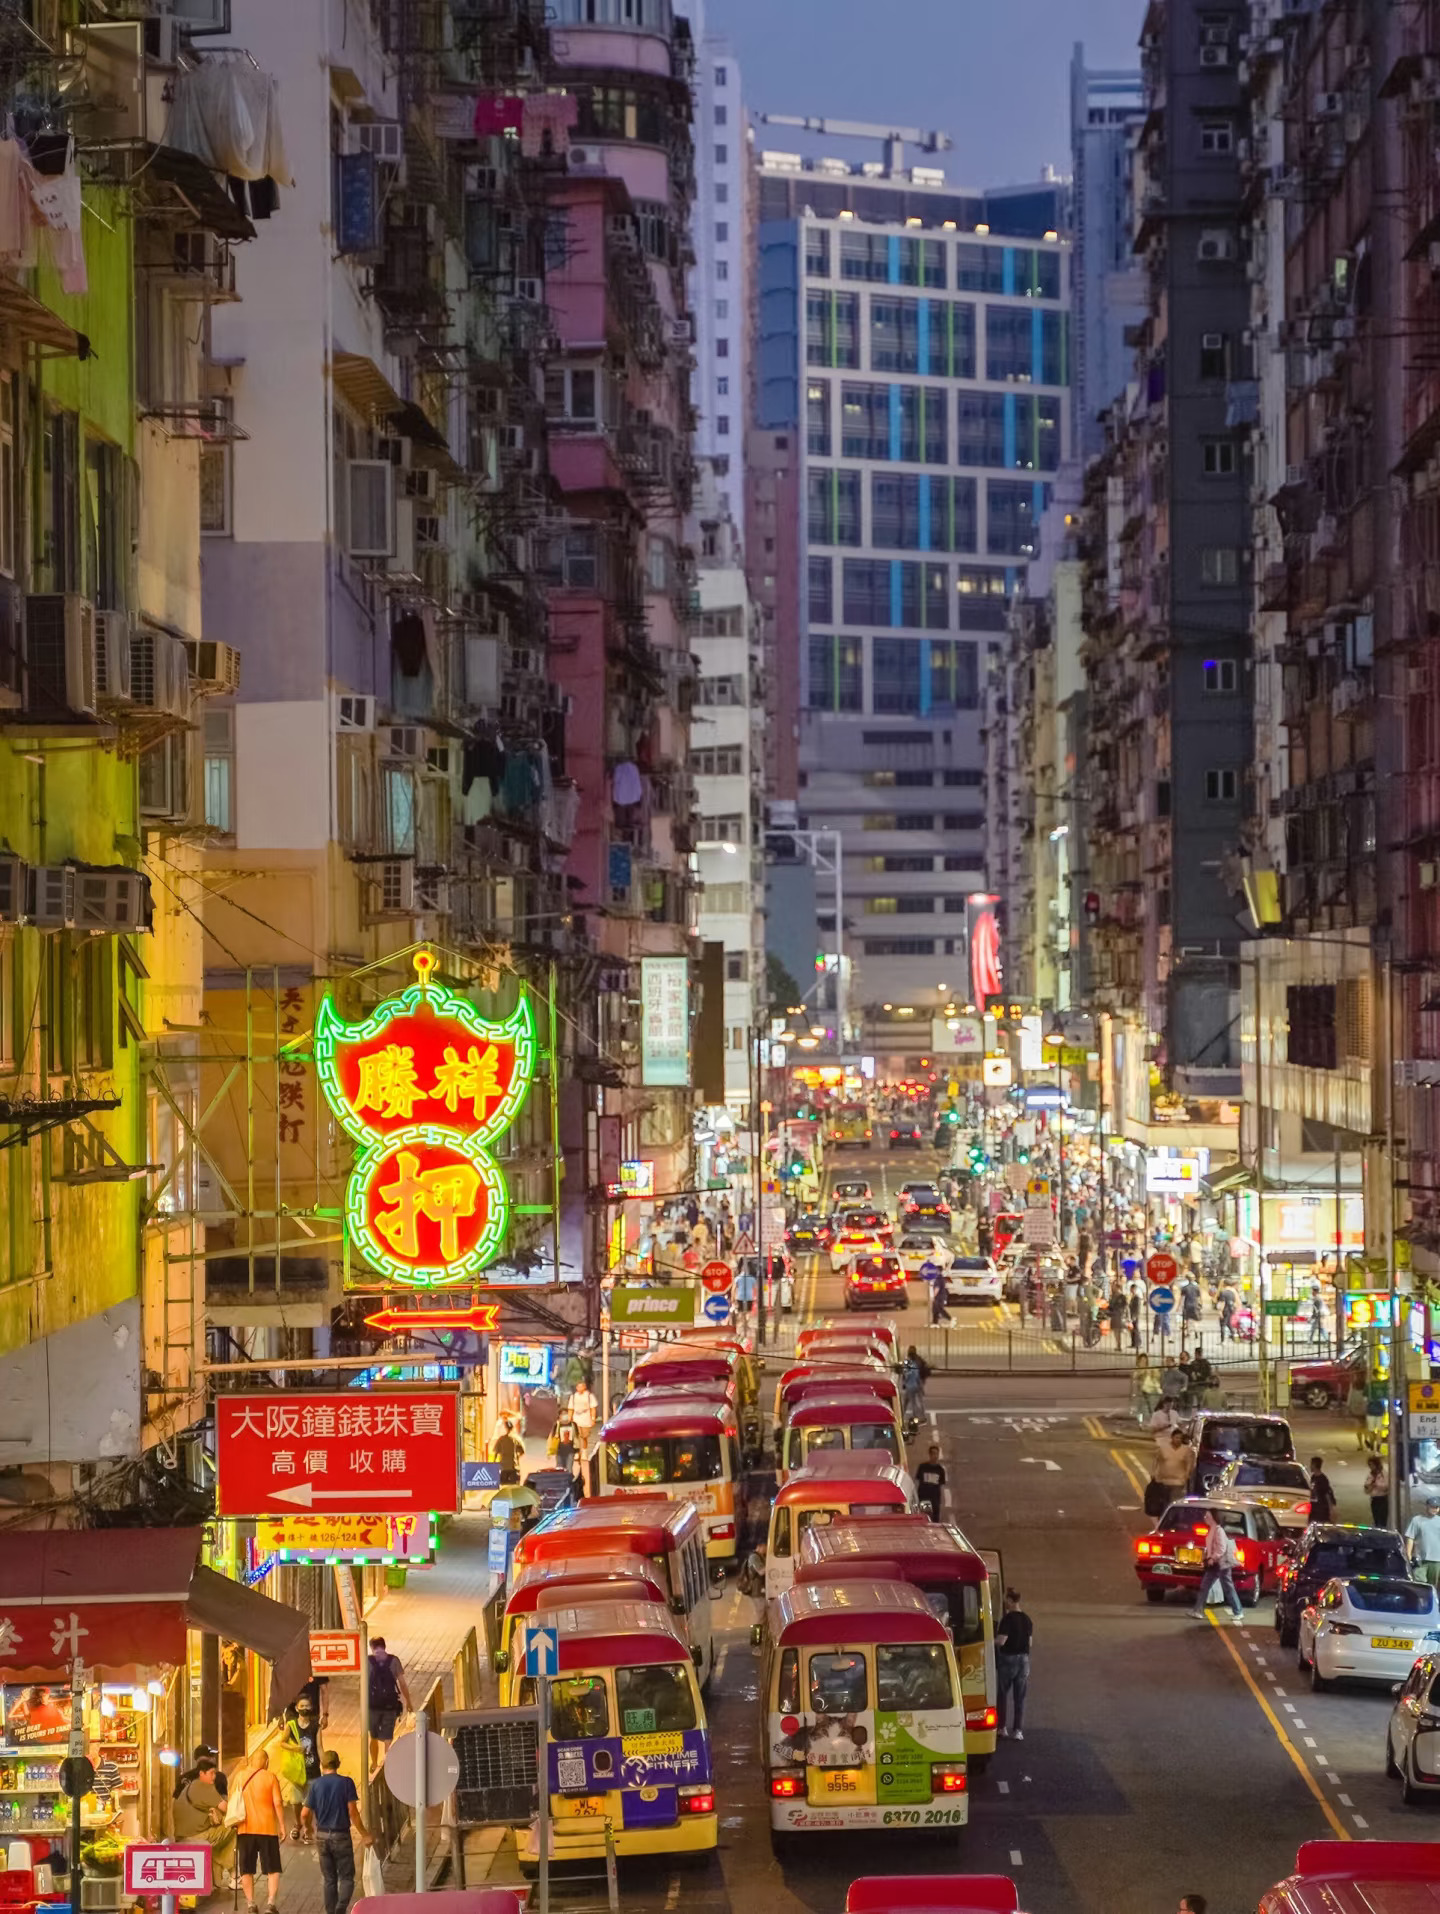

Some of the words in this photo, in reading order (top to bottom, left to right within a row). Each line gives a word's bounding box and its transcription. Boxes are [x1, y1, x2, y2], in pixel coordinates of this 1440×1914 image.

[374, 1150, 481, 1261] 押
[1150, 1260, 1173, 1268] STOP
[706, 1268, 728, 1277] STOP
[230, 1403, 444, 1439] 大阪鐘錶珠寶
[271, 1449, 329, 1474] 高價
[349, 1448, 407, 1474] 收購
[14, 1727, 26, 1736] THE
[19, 1734, 26, 1742] IS
[27, 1729, 47, 1740] YOURS
[47, 1727, 55, 1736] TO
[647, 1750, 698, 1762] ANYTIME
[649, 1759, 699, 1770] FITNESS
[834, 1774, 849, 1783] FF
[827, 1782, 857, 1792] 9995
[580, 1799, 593, 1809] WL
[883, 1810, 920, 1824] 6370
